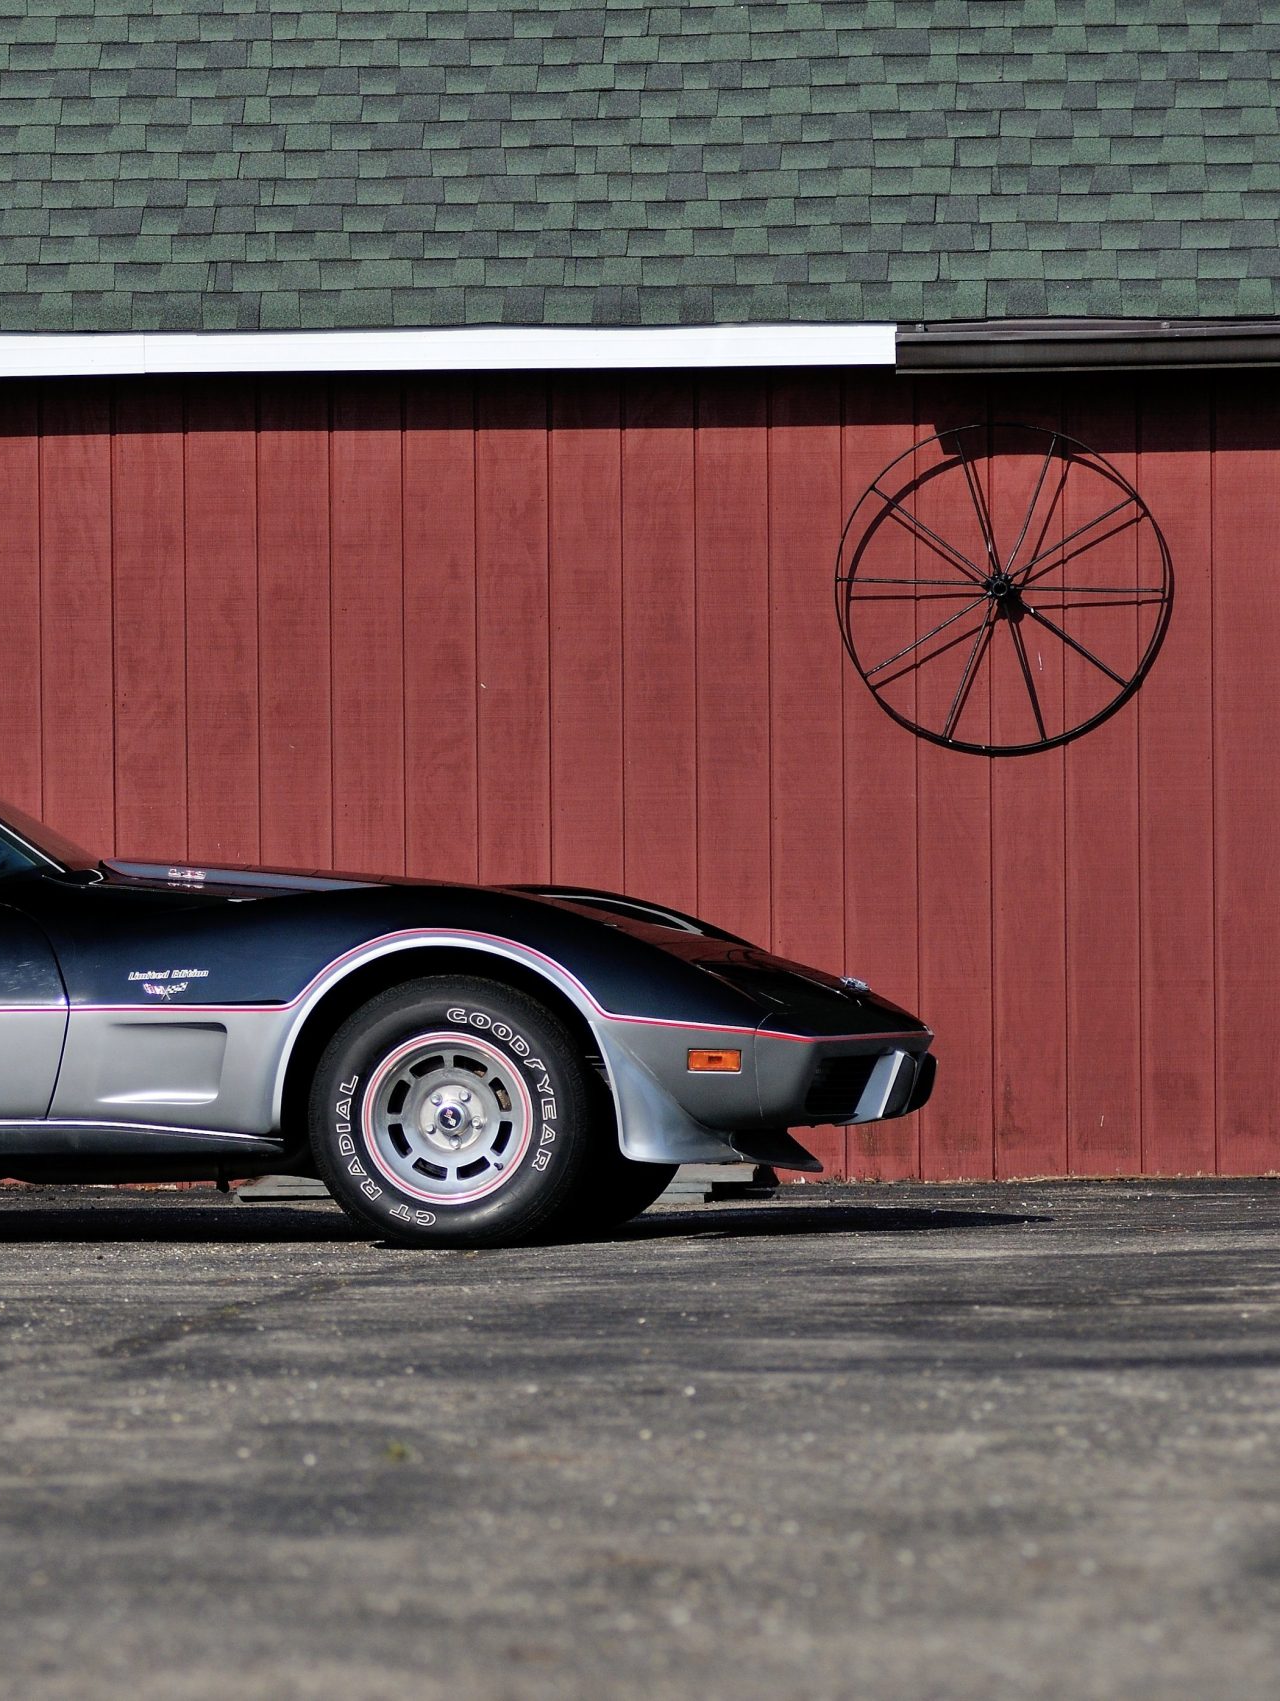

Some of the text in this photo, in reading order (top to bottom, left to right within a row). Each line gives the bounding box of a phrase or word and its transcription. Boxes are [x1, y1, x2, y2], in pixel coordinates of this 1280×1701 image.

[128, 968, 209, 981] Limited Edition
[336, 1075, 436, 1226] GT RADIAL
[446, 1008, 557, 1172] GOODYEAR
